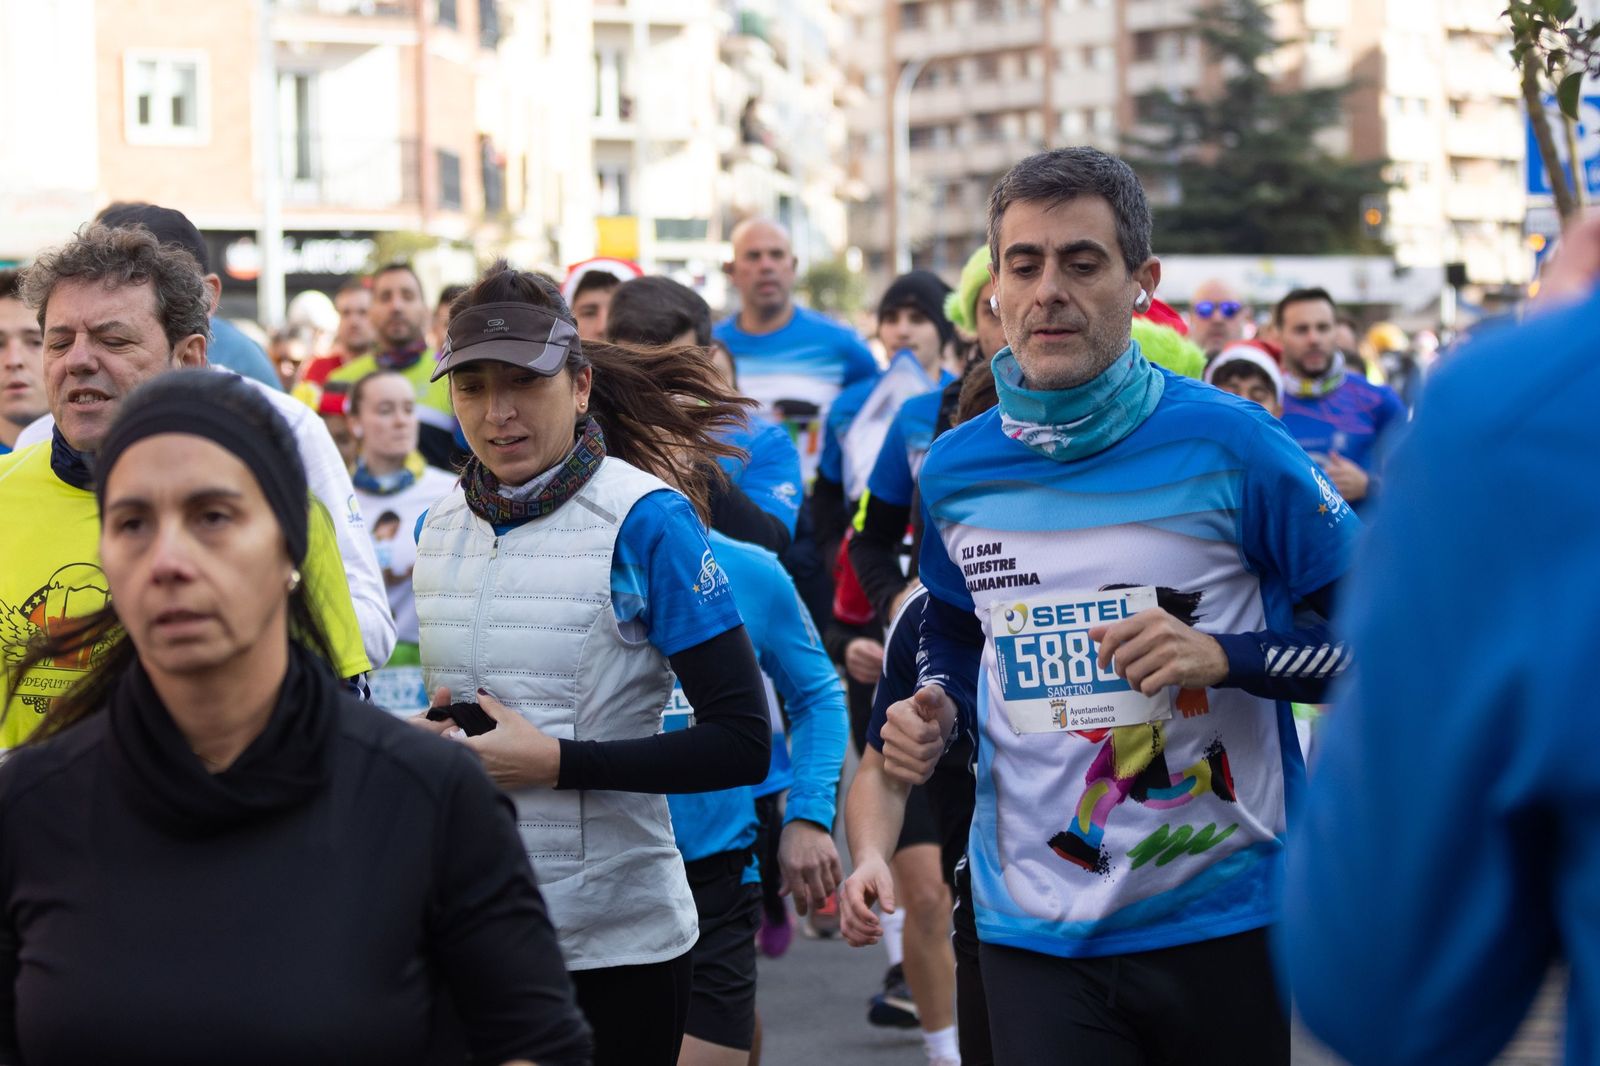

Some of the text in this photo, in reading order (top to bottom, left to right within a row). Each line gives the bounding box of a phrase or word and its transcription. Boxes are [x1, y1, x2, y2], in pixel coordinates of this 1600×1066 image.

[962, 542, 1002, 561] XLI SAN
[964, 557, 1016, 577] SILVESTRE
[1032, 598, 1140, 627] SETEL
[1047, 684, 1093, 698] SANTINO
[1070, 704, 1115, 717] Ayuntamiento
[1080, 716, 1115, 726] Salamanca
